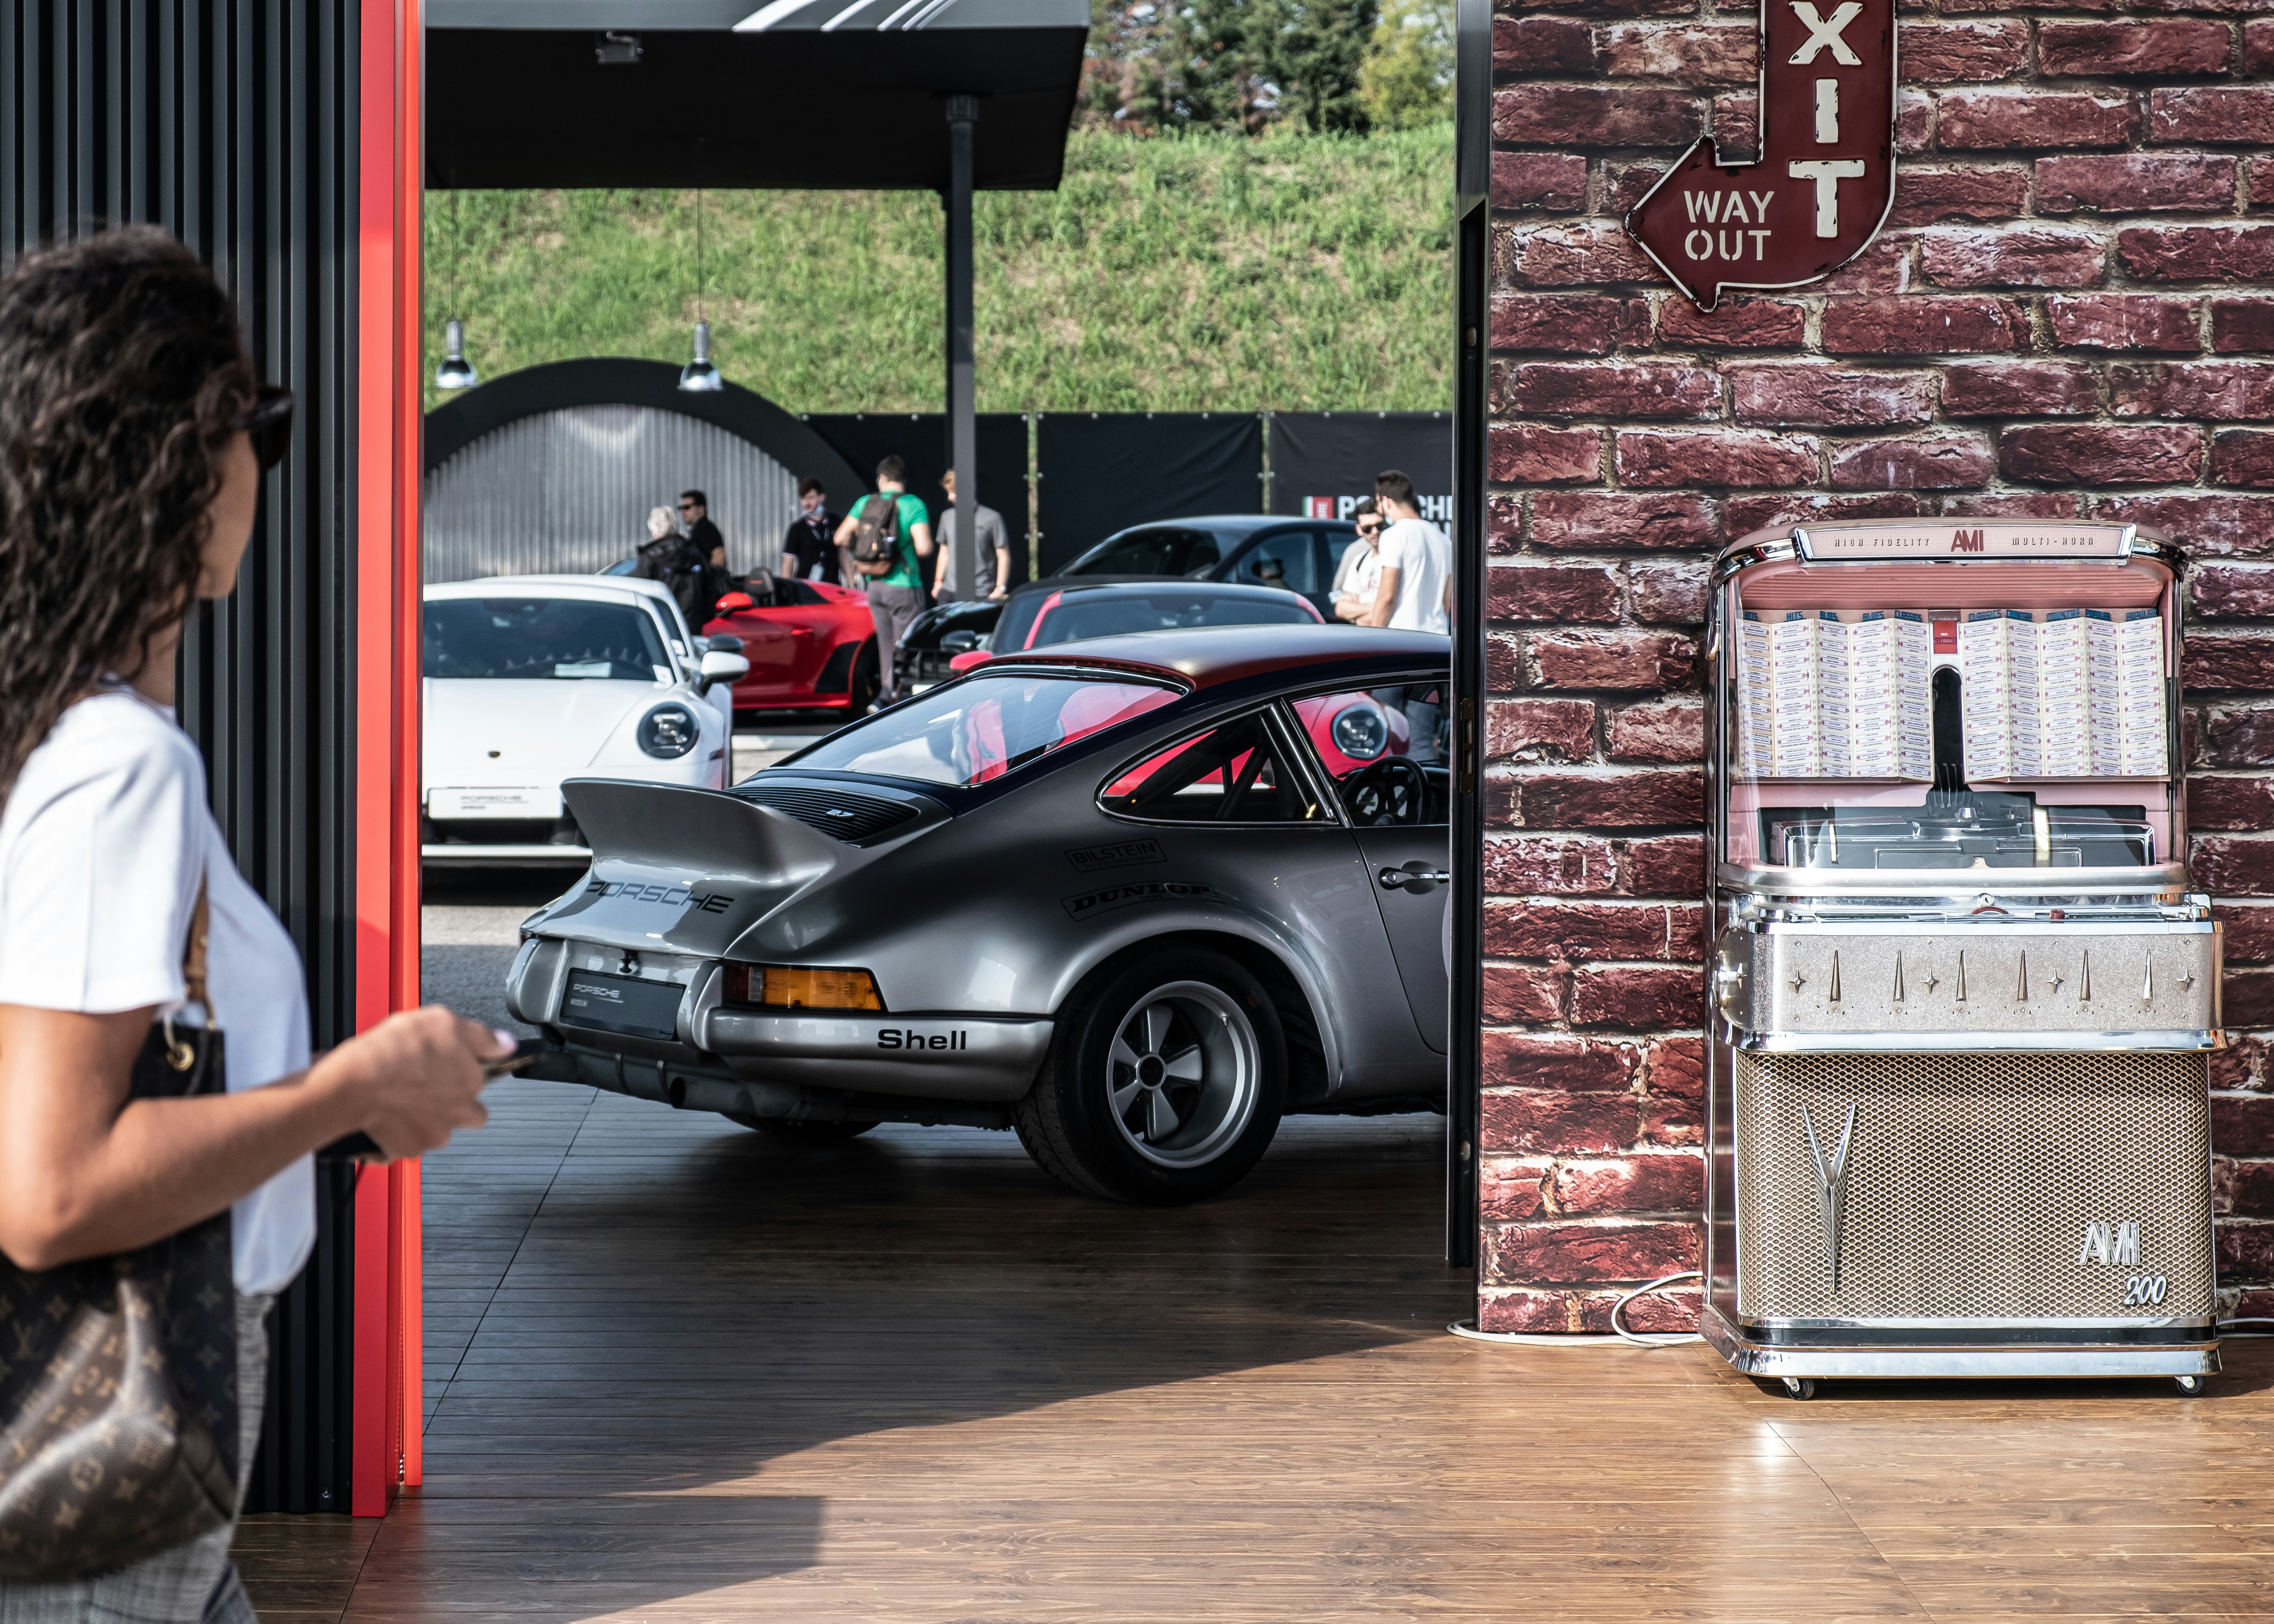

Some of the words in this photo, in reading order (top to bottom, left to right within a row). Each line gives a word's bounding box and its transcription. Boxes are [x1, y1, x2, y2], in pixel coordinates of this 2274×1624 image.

[1684, 190, 1774, 223] WAY
[1685, 229, 1771, 260] OUT
[1835, 538, 1863, 546] HIGH
[1873, 538, 1929, 546] FIDELITY
[1951, 529, 1984, 552] AMI
[1744, 611, 1758, 620] HITS
[1786, 611, 1803, 621] HITS
[1073, 842, 1156, 863] BILSTEIN
[1113, 855, 1157, 864] ABSORBERS
[585, 881, 734, 914] PORSCHE
[1073, 884, 1210, 912] DUNLOP
[573, 984, 620, 998] PORSCHE
[877, 1029, 967, 1050] Shell
[2079, 1222, 2140, 1265] AMI
[2123, 1275, 2167, 1305] 200
